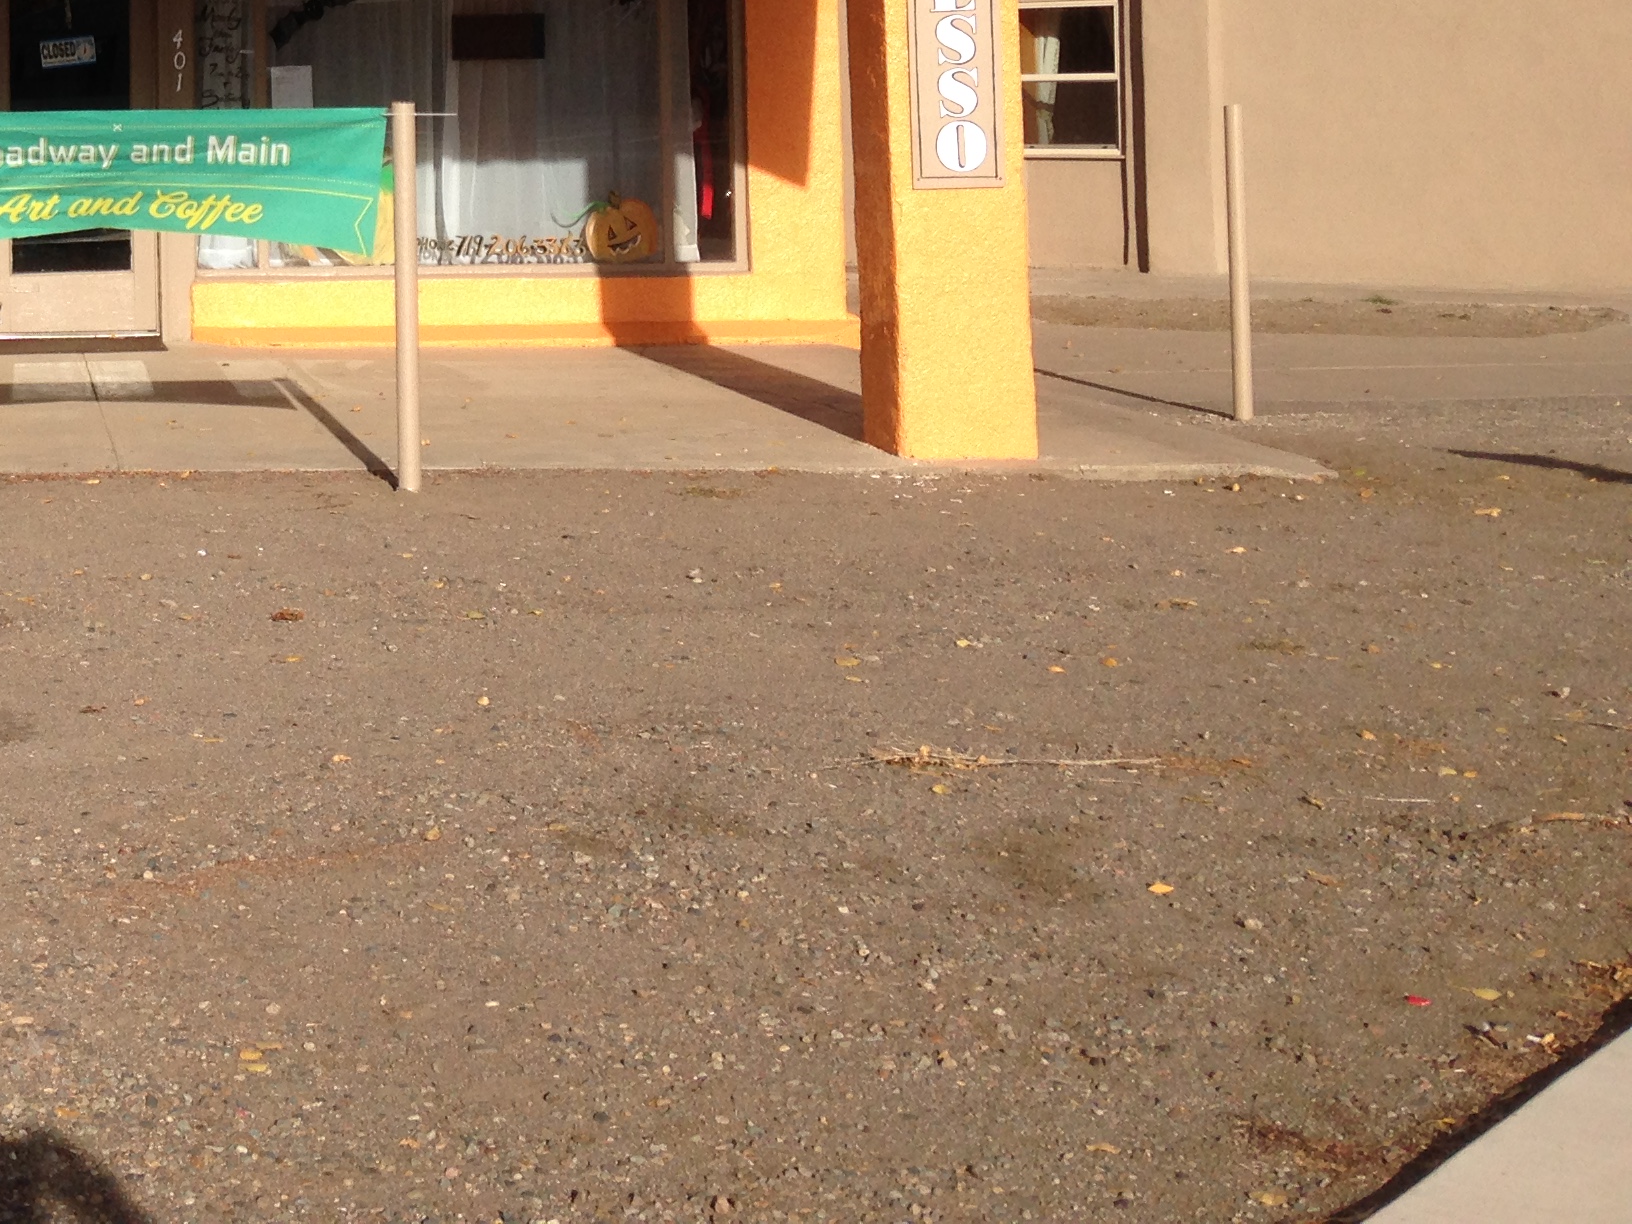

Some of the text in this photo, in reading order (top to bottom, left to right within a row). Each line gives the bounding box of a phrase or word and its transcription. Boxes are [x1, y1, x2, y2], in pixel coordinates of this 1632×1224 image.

[41, 40, 77, 60] CLOSED
[172, 29, 186, 92] 401
[130, 134, 195, 165] and
[206, 134, 292, 167] Main
[68, 190, 143, 218] and
[148, 189, 264, 230] Coffee
